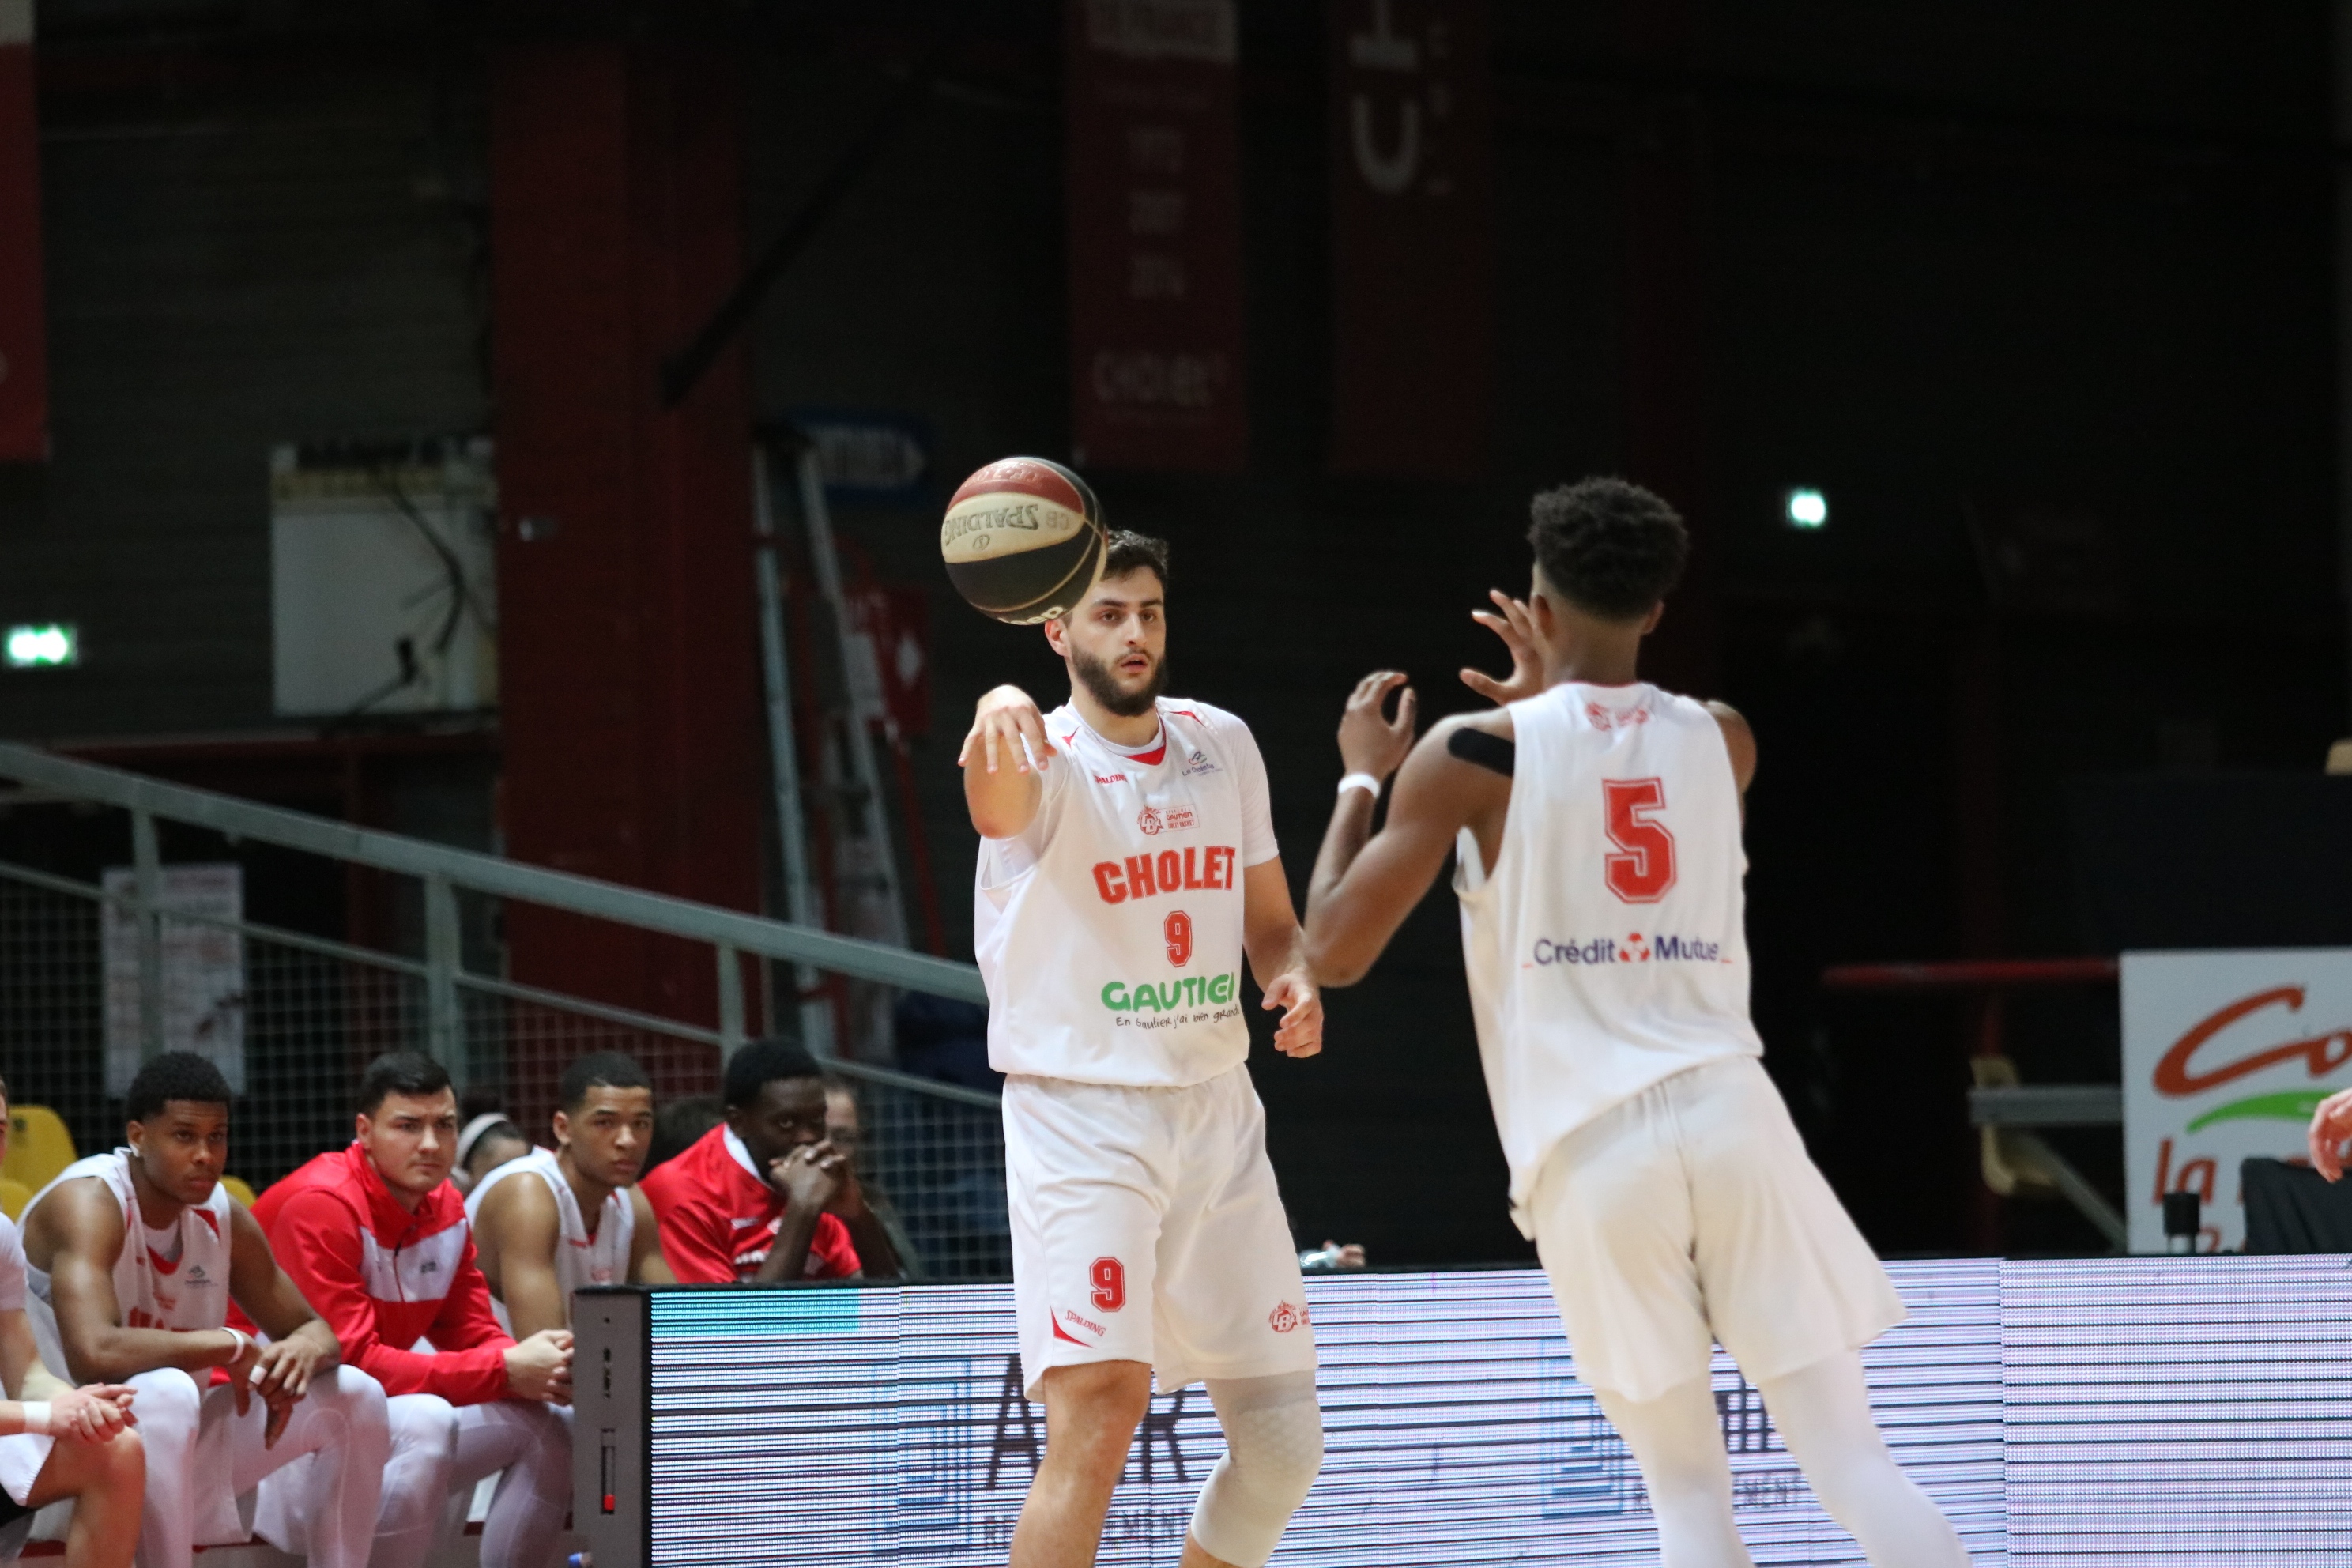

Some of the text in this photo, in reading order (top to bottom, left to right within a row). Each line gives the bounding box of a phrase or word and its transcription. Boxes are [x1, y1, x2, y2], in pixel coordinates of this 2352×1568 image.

[1602, 776, 1677, 905] 5
[1091, 846, 1236, 906] CHOLET
[1163, 910, 1193, 968] 9
[1534, 935, 1719, 965] Crédit Mutue
[1089, 1257, 1126, 1314] 9
[1064, 1309, 1106, 1337] SPALDING
